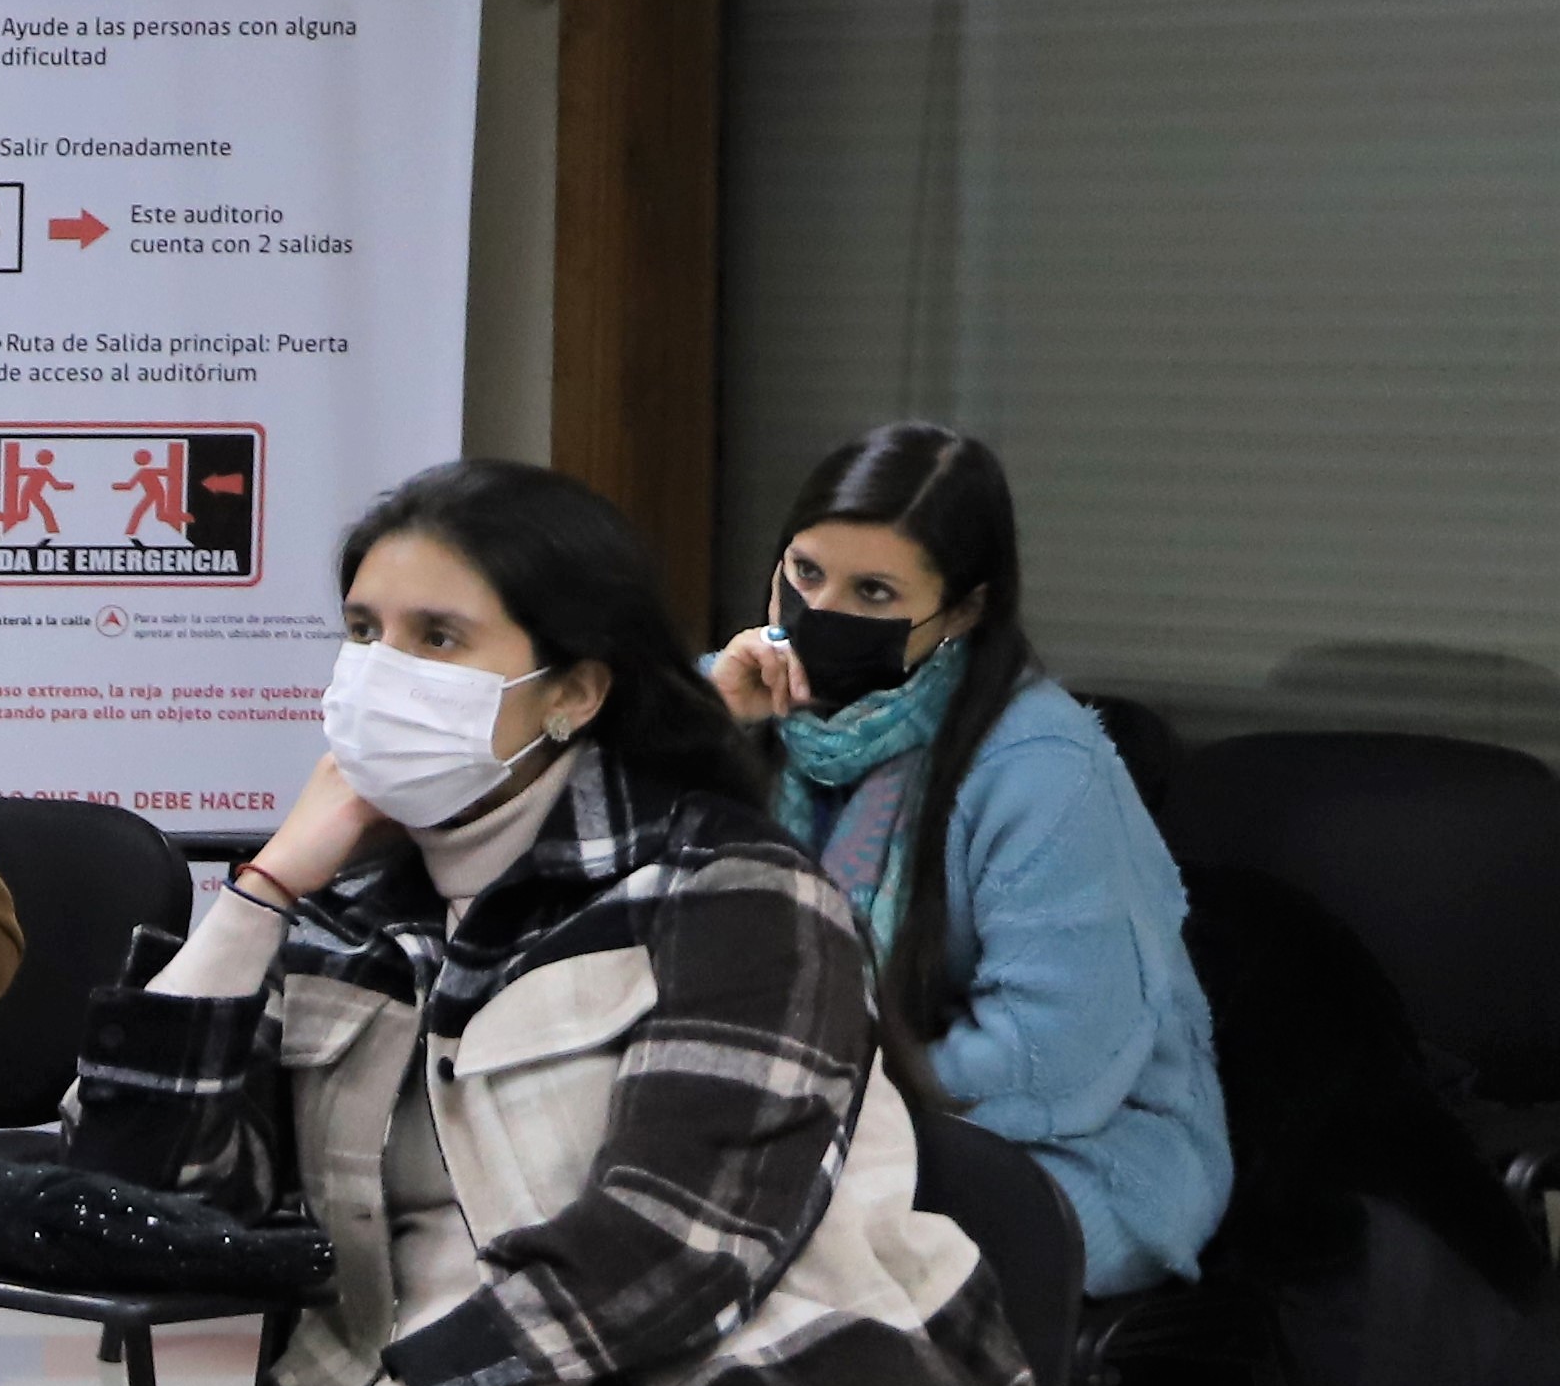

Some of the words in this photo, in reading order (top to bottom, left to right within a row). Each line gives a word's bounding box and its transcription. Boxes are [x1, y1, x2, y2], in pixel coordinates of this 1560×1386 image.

[1, 16, 69, 42] Ayude
[76, 21, 88, 37] a
[95, 16, 126, 37] las
[133, 20, 232, 40] personas
[238, 20, 278, 36] con
[285, 15, 357, 41] alguna
[1, 46, 107, 67] dificultad
[0, 137, 49, 157] Salir
[55, 137, 232, 157] Ordenadamente
[130, 204, 176, 224] Este
[183, 204, 284, 224] auditorio
[130, 236, 204, 254] cuenta
[211, 238, 250, 254] con
[258, 234, 271, 254] 2
[278, 234, 353, 254] salidas
[62, 333, 89, 353] de
[95, 333, 163, 353] Salida
[169, 333, 271, 357] principal:
[277, 333, 350, 354] Puerta
[28, 366, 104, 382] acceso
[110, 362, 130, 382] al
[36, 548, 69, 572] DE
[74, 548, 239, 573] EMERGENCIA
[27, 685, 104, 700] extremo,
[108, 683, 125, 699] la
[129, 684, 163, 702] reja
[171, 683, 226, 702] puede
[229, 686, 256, 699] ser
[260, 683, 325, 702] quebra
[50, 708, 89, 723] para
[92, 705, 126, 720] ello
[130, 708, 153, 720] un
[156, 705, 213, 724] objeto
[134, 791, 193, 810] DEBE
[200, 791, 275, 811] HACER
